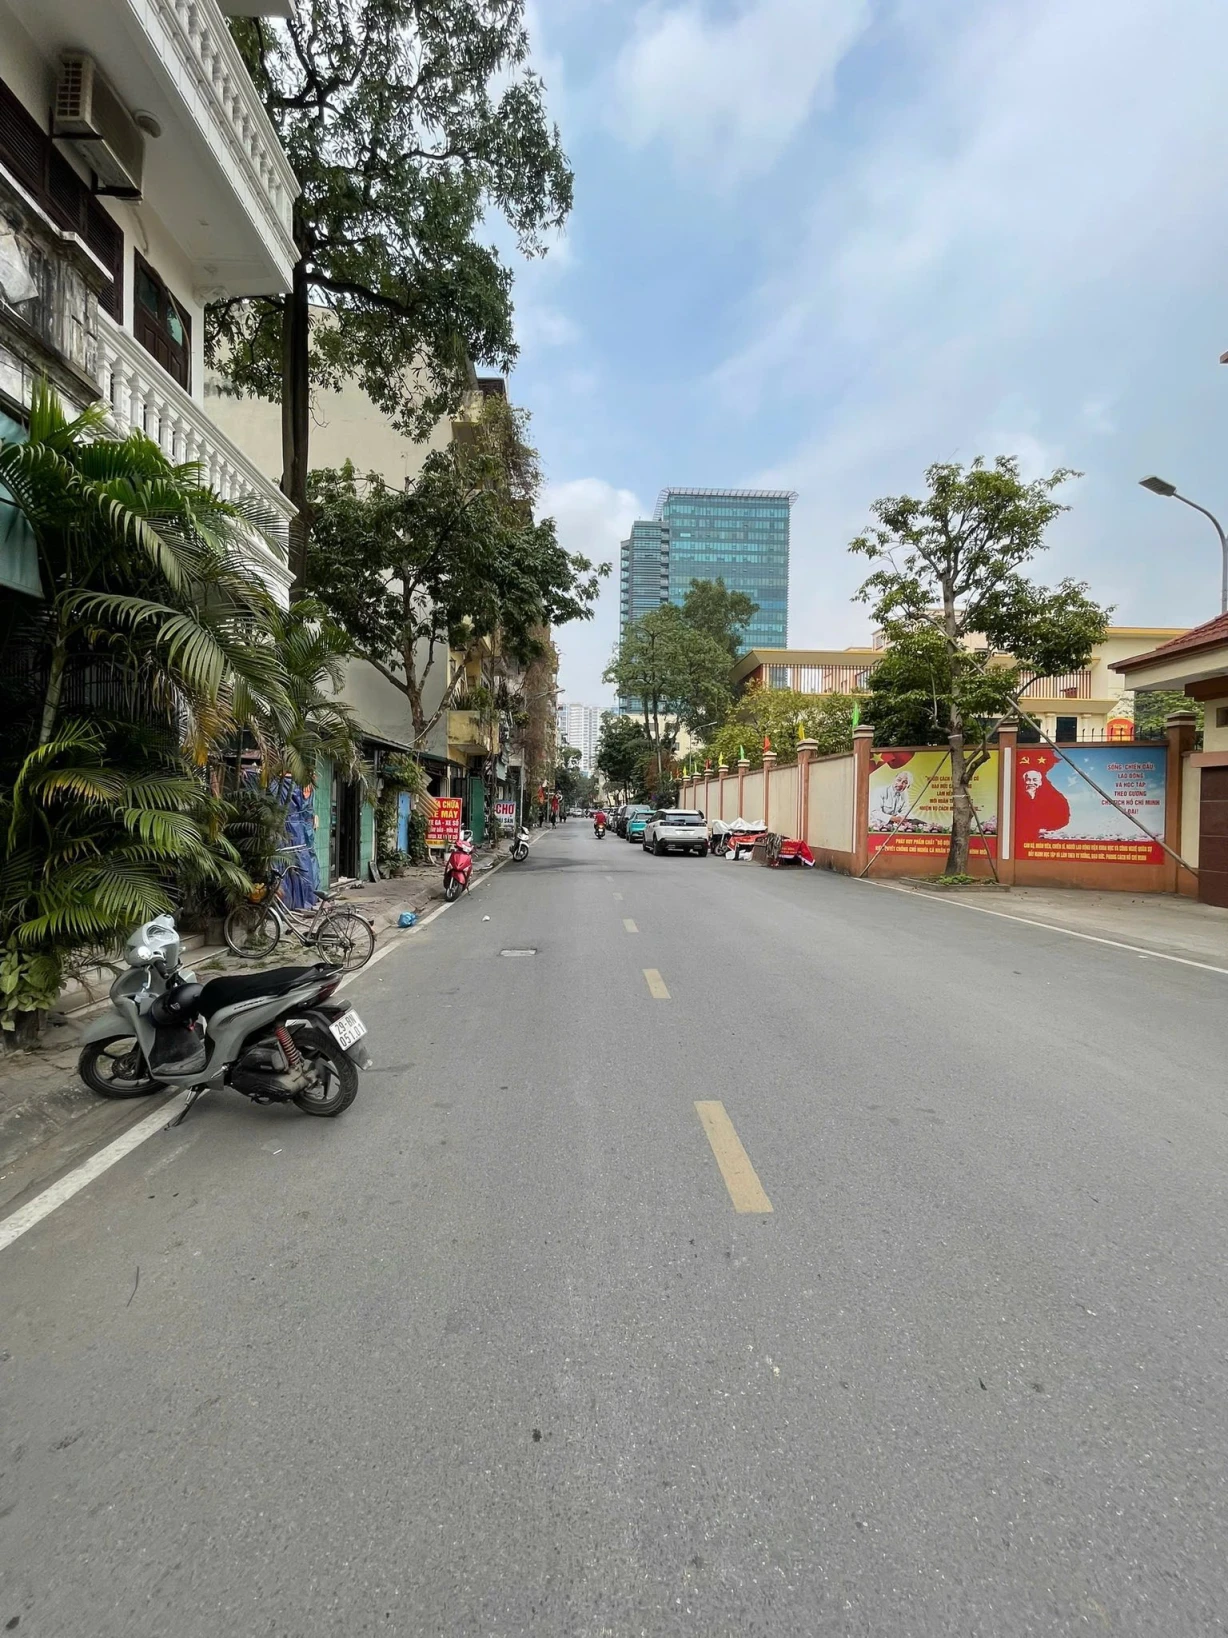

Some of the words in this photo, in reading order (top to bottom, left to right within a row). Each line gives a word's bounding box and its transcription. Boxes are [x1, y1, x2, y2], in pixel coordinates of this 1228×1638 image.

[1123, 781, 1135, 789] HỌC
[442, 800, 459, 809] CHỮA
[441, 809, 459, 819] MÁY
[495, 803, 514, 818] CHỢ
[339, 1023, 365, 1047] 051.01
